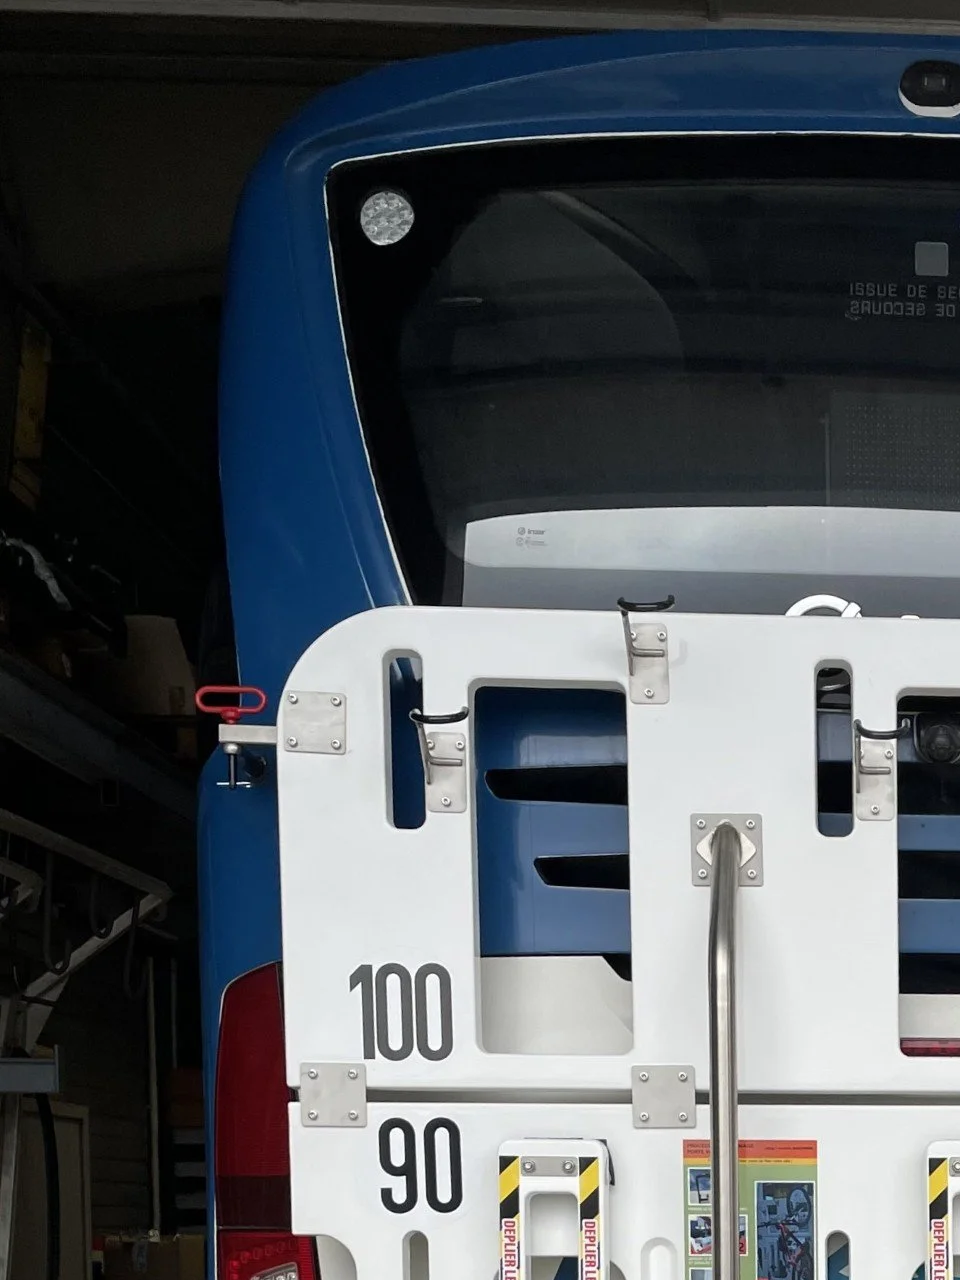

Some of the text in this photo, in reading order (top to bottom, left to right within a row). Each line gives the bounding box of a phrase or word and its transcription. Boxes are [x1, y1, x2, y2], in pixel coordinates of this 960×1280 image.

[850, 282, 898, 297] ISSUE
[907, 284, 928, 298] DE
[349, 962, 454, 1062] 100
[378, 1117, 463, 1215] 90
[504, 1220, 517, 1267] DEPLIER
[584, 1221, 596, 1267] DEPLIER
[933, 1221, 945, 1267] DEPLIER
